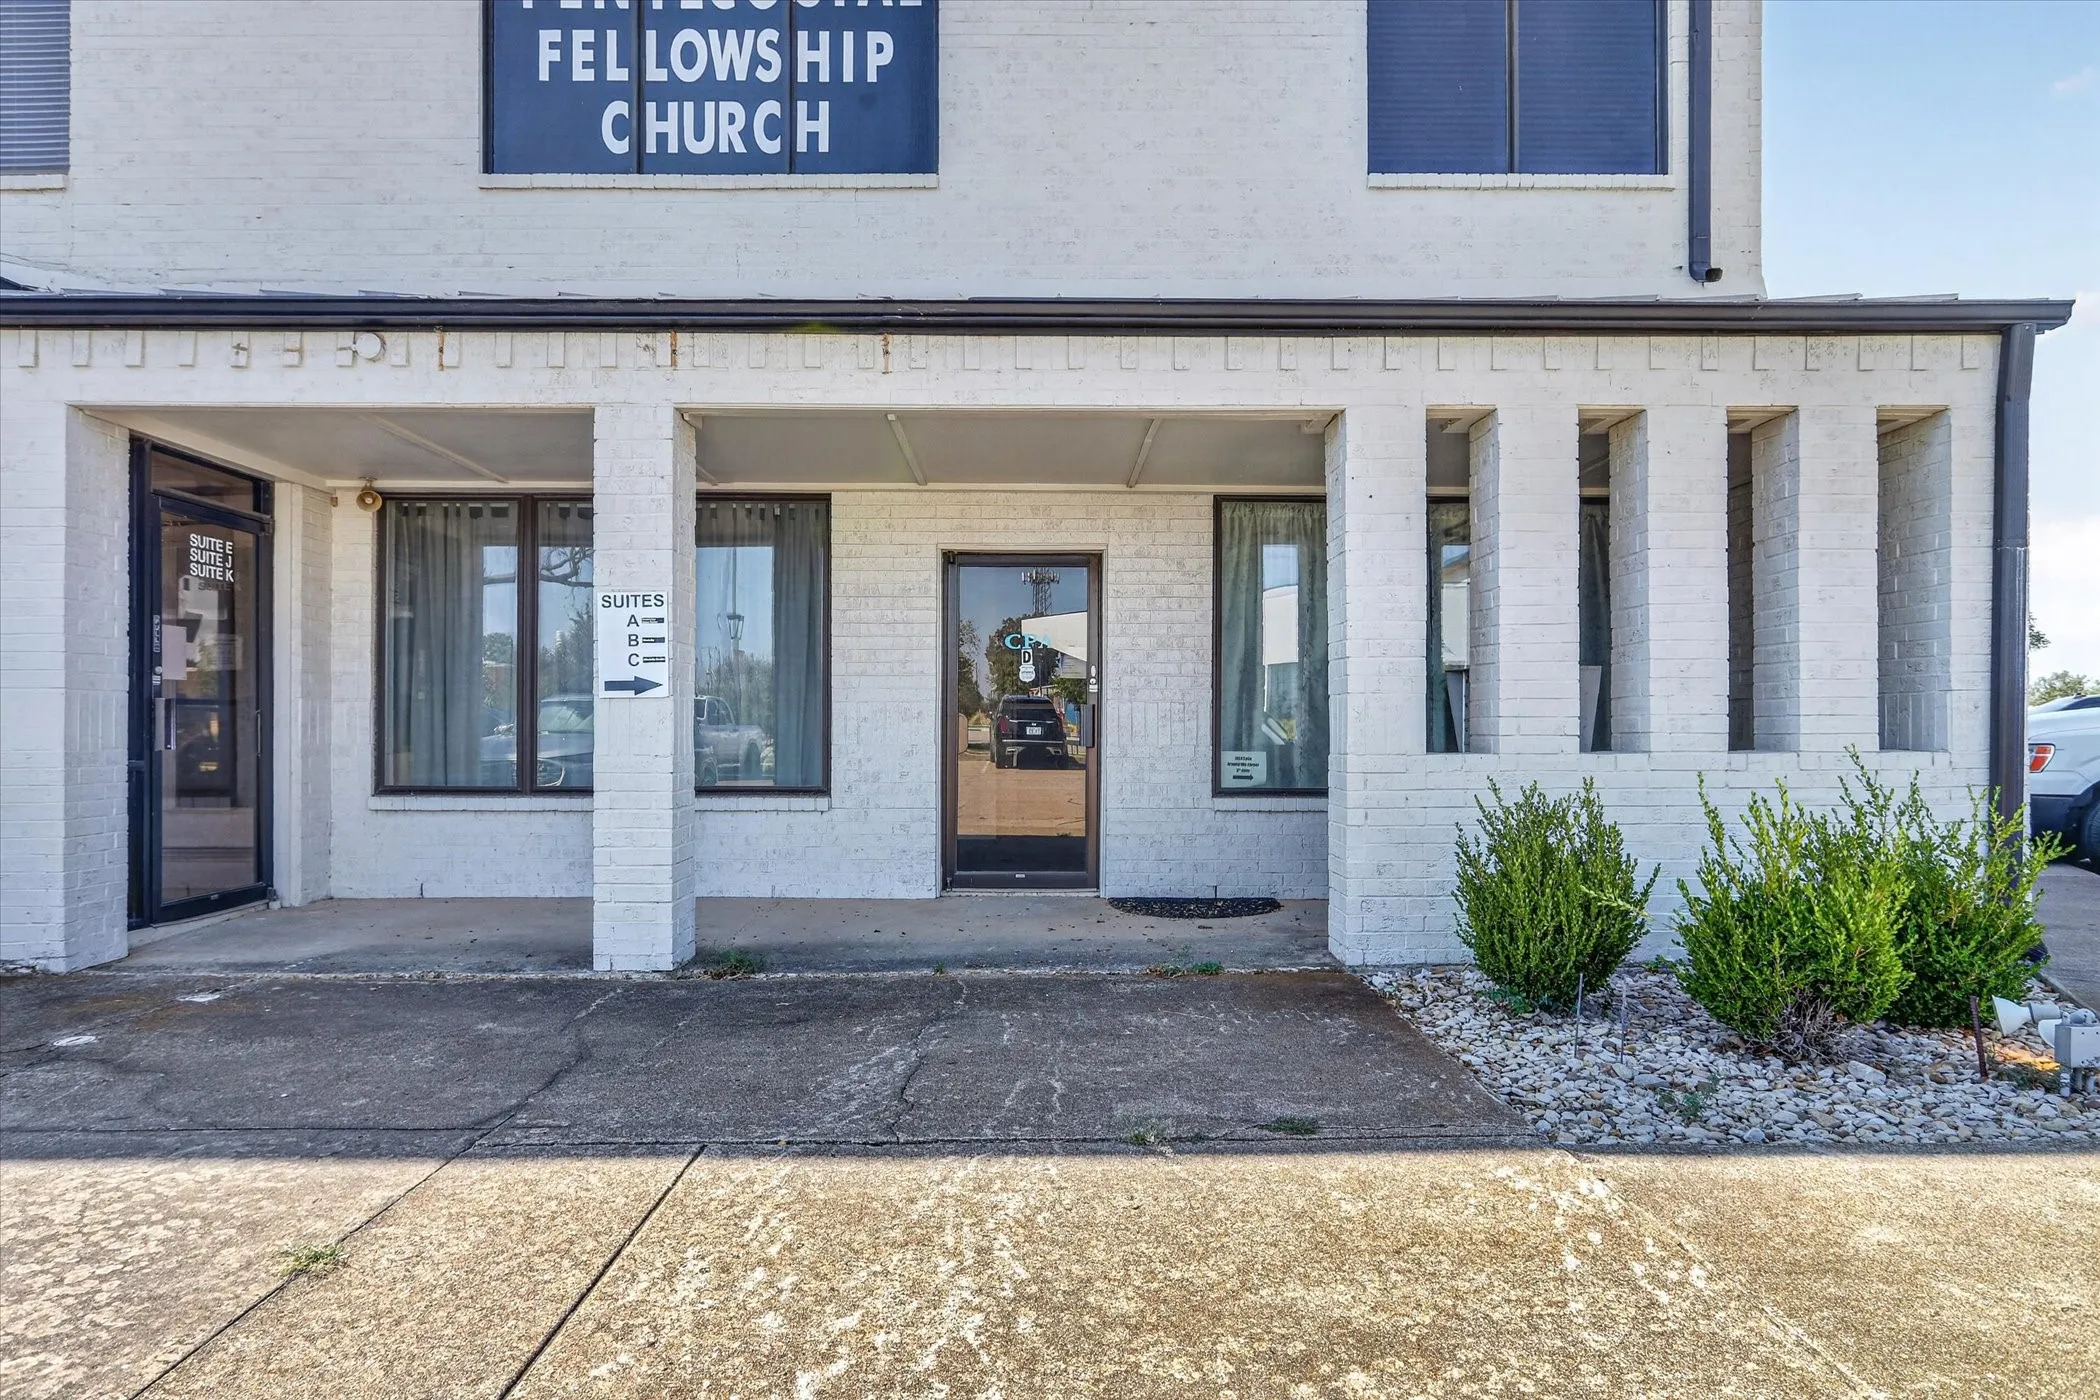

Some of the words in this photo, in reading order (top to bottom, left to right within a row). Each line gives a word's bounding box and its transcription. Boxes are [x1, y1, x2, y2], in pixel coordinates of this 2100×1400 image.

[538, 27, 895, 83] FELLOWSHIP
[601, 99, 830, 155] CHURCH
[189, 533, 224, 553] SUITE
[225, 541, 234, 554] E
[189, 547, 224, 567] SUITE
[225, 555, 233, 568] J
[189, 562, 224, 581] SUITE
[225, 568, 235, 583] K
[601, 593, 665, 609] SUITES
[627, 614, 640, 628] A
[628, 633, 640, 647] B
[628, 652, 640, 667] C
[1022, 650, 1032, 664] D
